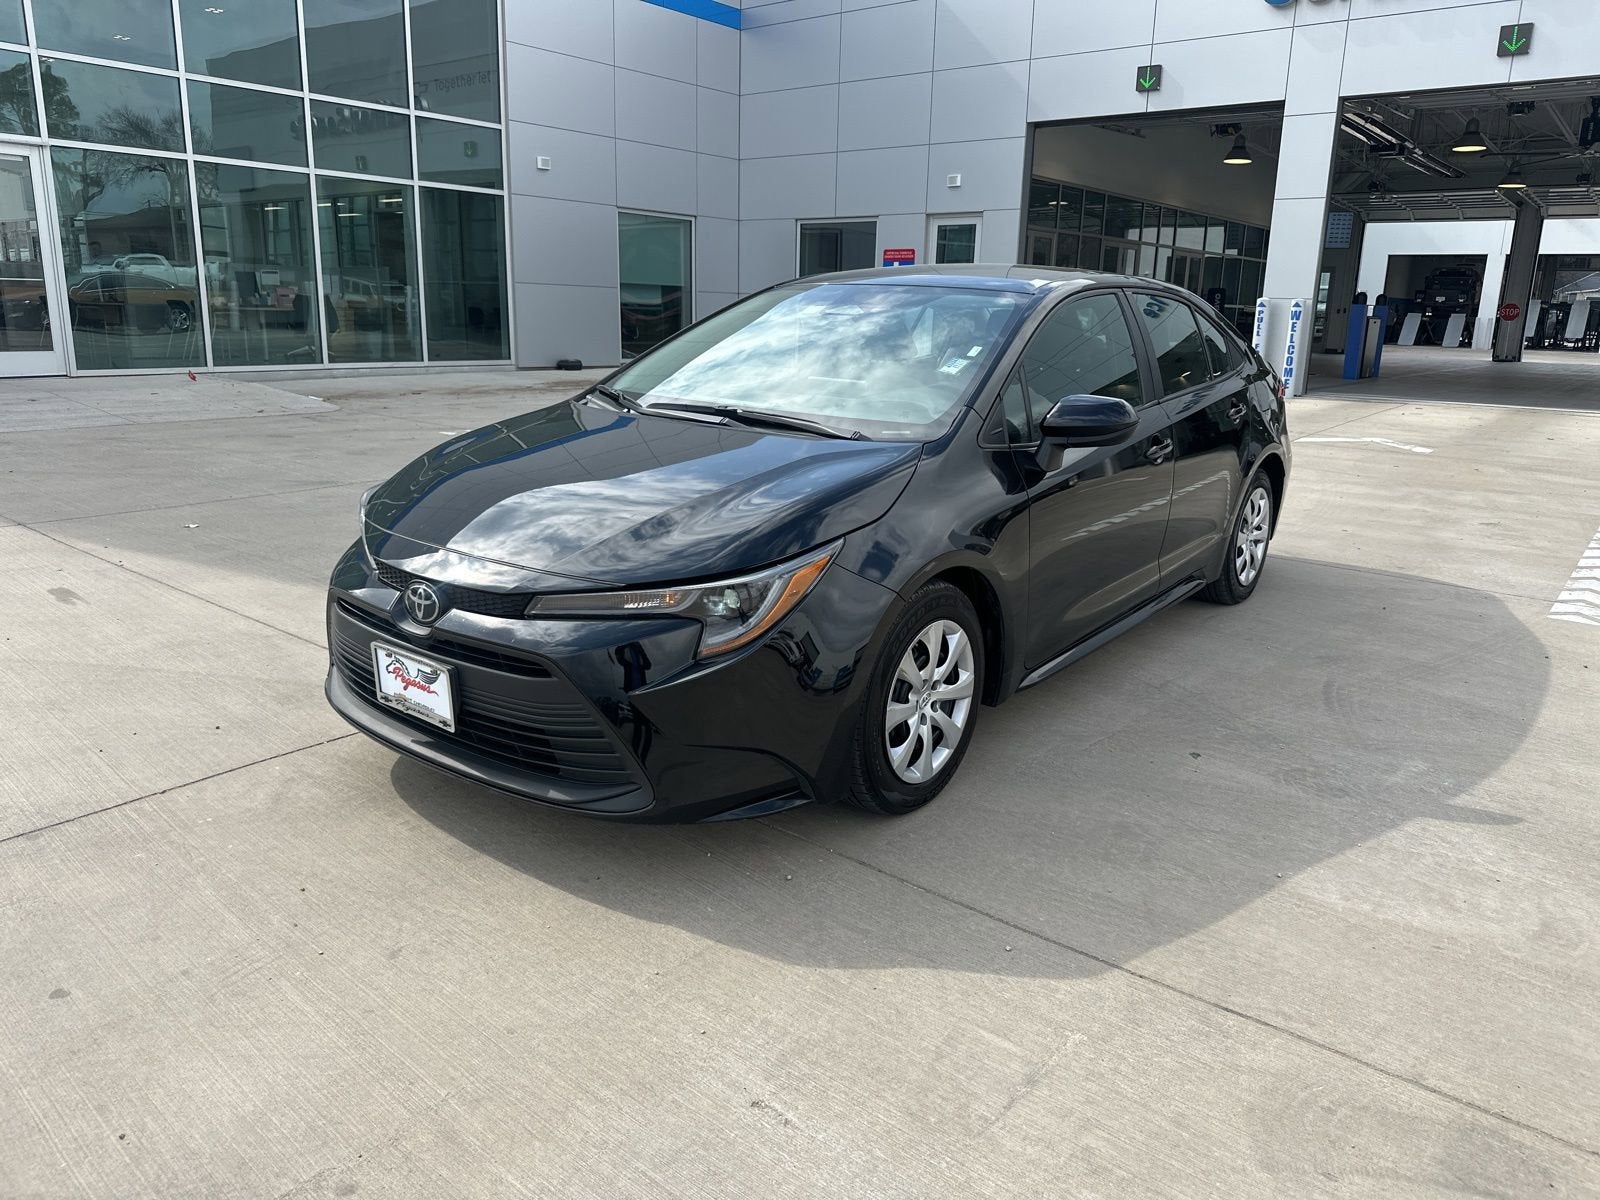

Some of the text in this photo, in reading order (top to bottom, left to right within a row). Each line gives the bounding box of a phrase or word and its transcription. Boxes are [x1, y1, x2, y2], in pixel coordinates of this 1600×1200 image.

[1256, 310, 1265, 337] PULL
[1501, 308, 1520, 316] STOP
[1283, 310, 1302, 389] WELCOME
[392, 666, 439, 696] Pegasus
